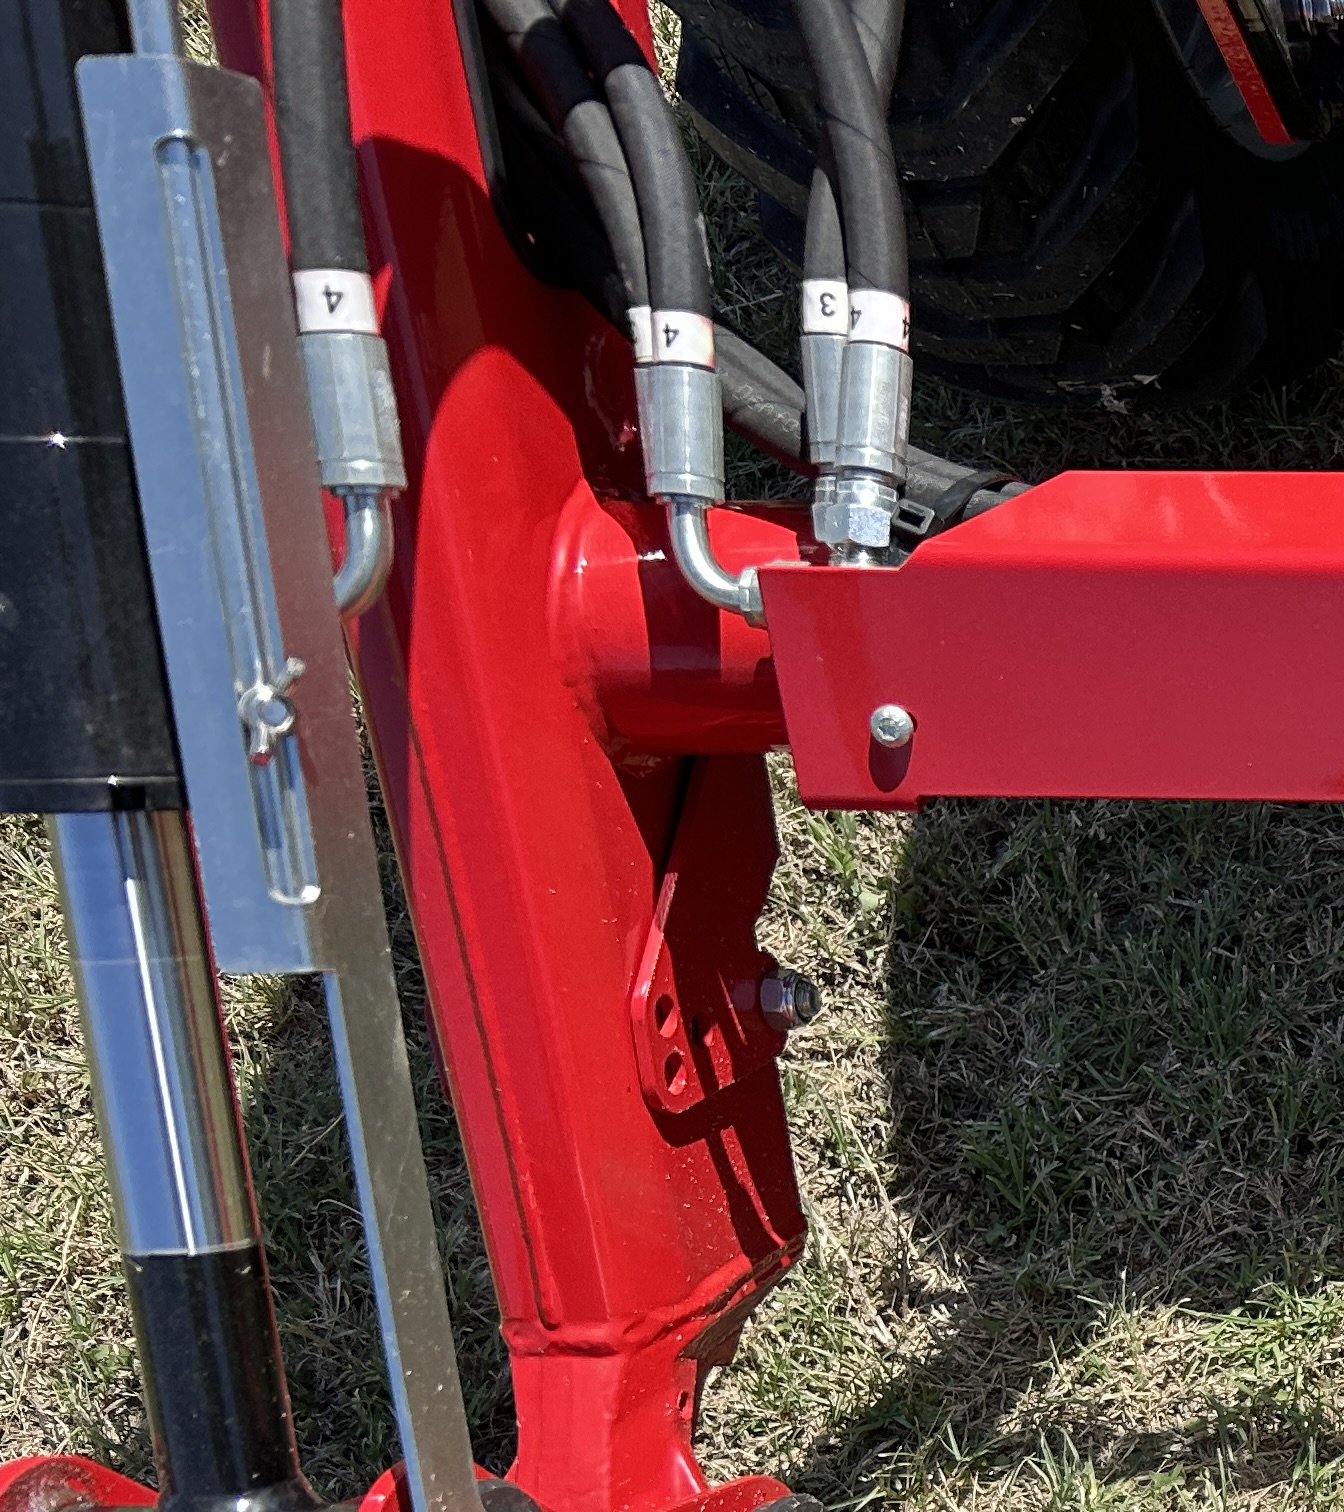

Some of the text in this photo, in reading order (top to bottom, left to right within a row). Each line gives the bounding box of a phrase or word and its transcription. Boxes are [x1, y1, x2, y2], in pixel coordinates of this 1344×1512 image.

[323, 283, 343, 314] 4
[820, 292, 836, 317] 3
[850, 306, 862, 330] 4
[662, 323, 680, 348] 4
